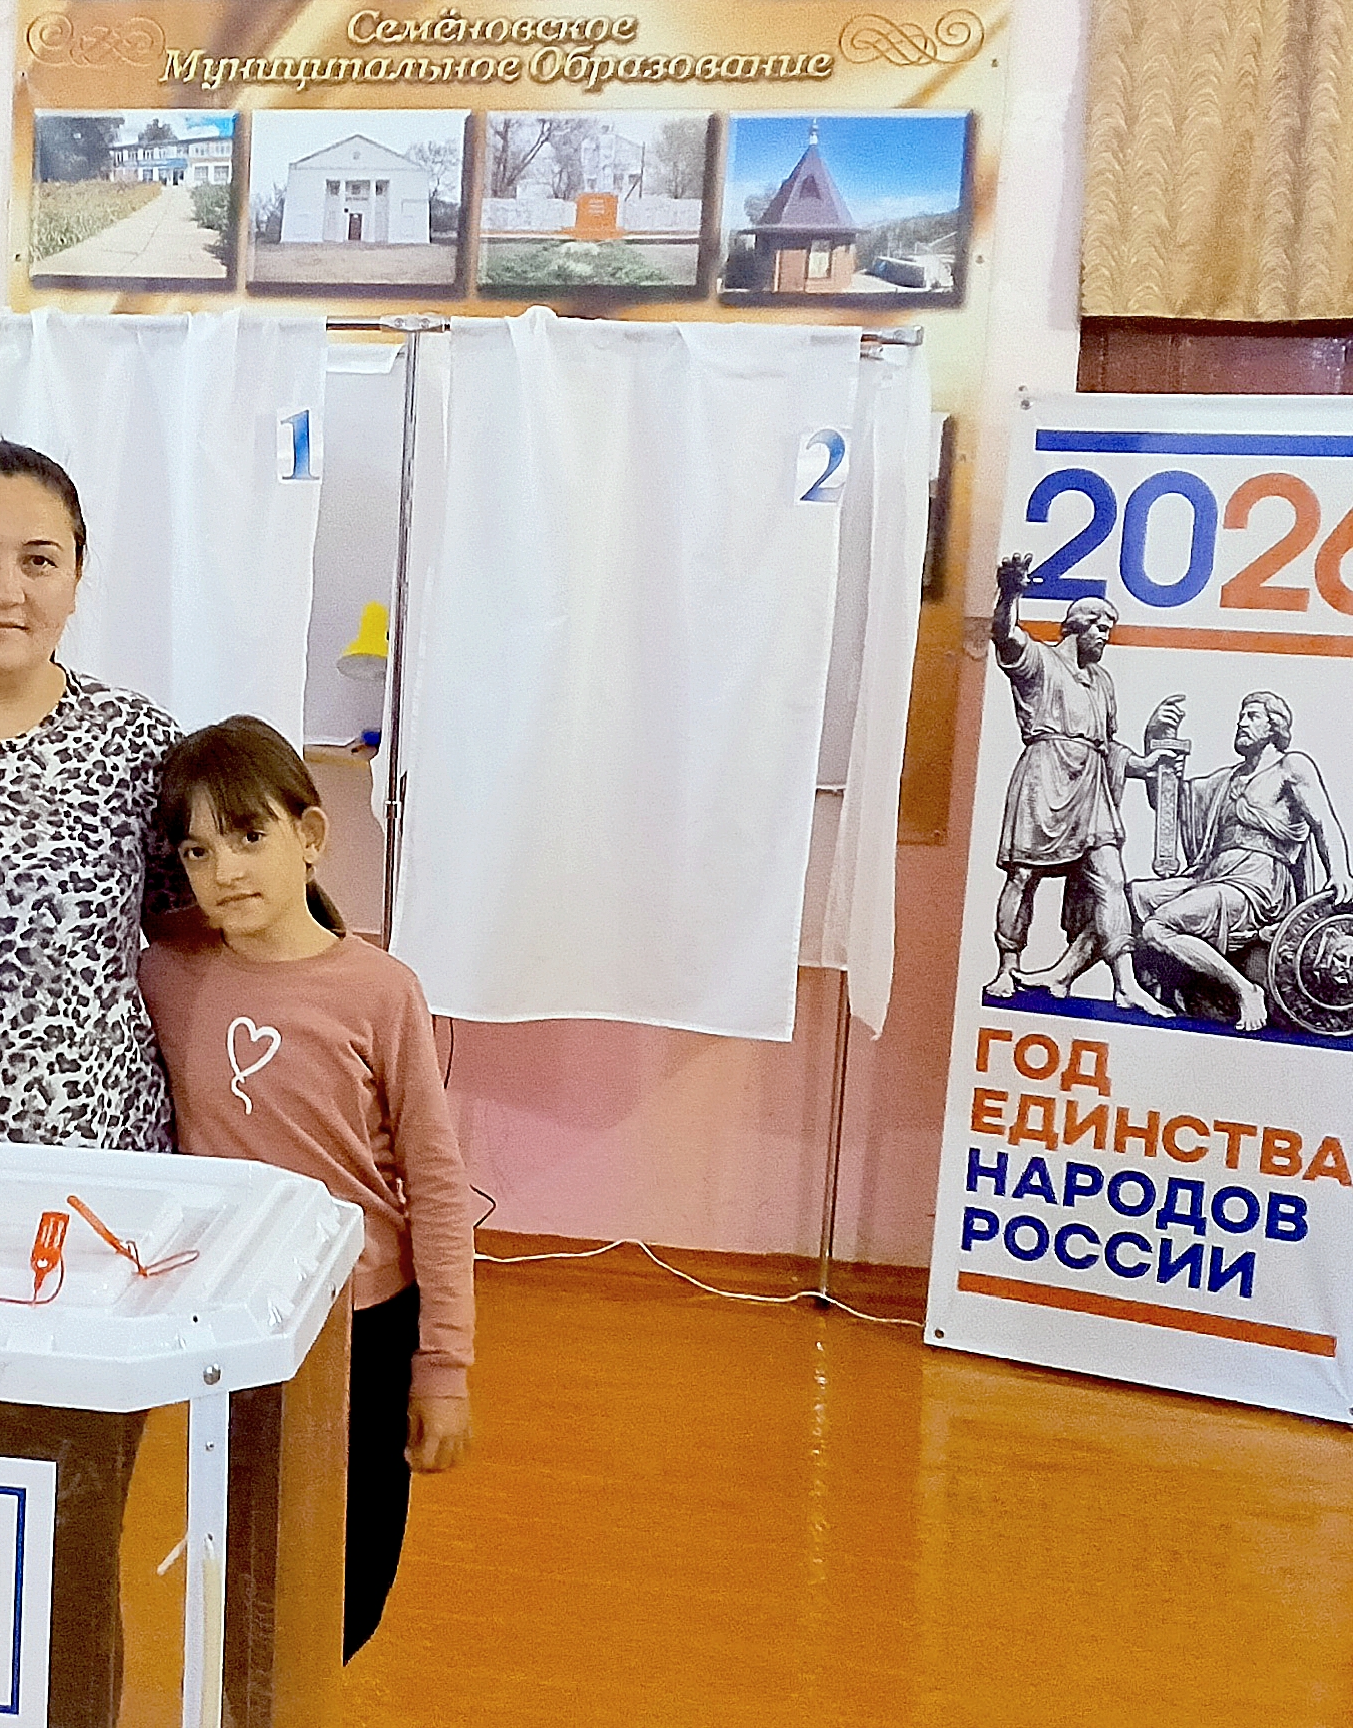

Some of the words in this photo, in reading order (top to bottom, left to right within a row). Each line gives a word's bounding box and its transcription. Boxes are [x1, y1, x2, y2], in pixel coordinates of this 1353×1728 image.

[347, 8, 638, 44] Семёновское
[159, 48, 520, 91] Муниципальное
[530, 45, 834, 92] Образование
[280, 409, 320, 480] 1
[799, 428, 846, 503] 2
[975, 1027, 1112, 1097] ГОД
[970, 1087, 1353, 1187] ЕДИНСТВА
[966, 1147, 1309, 1242] НАРОДОВ
[961, 1206, 1257, 1299] РОССИИ
